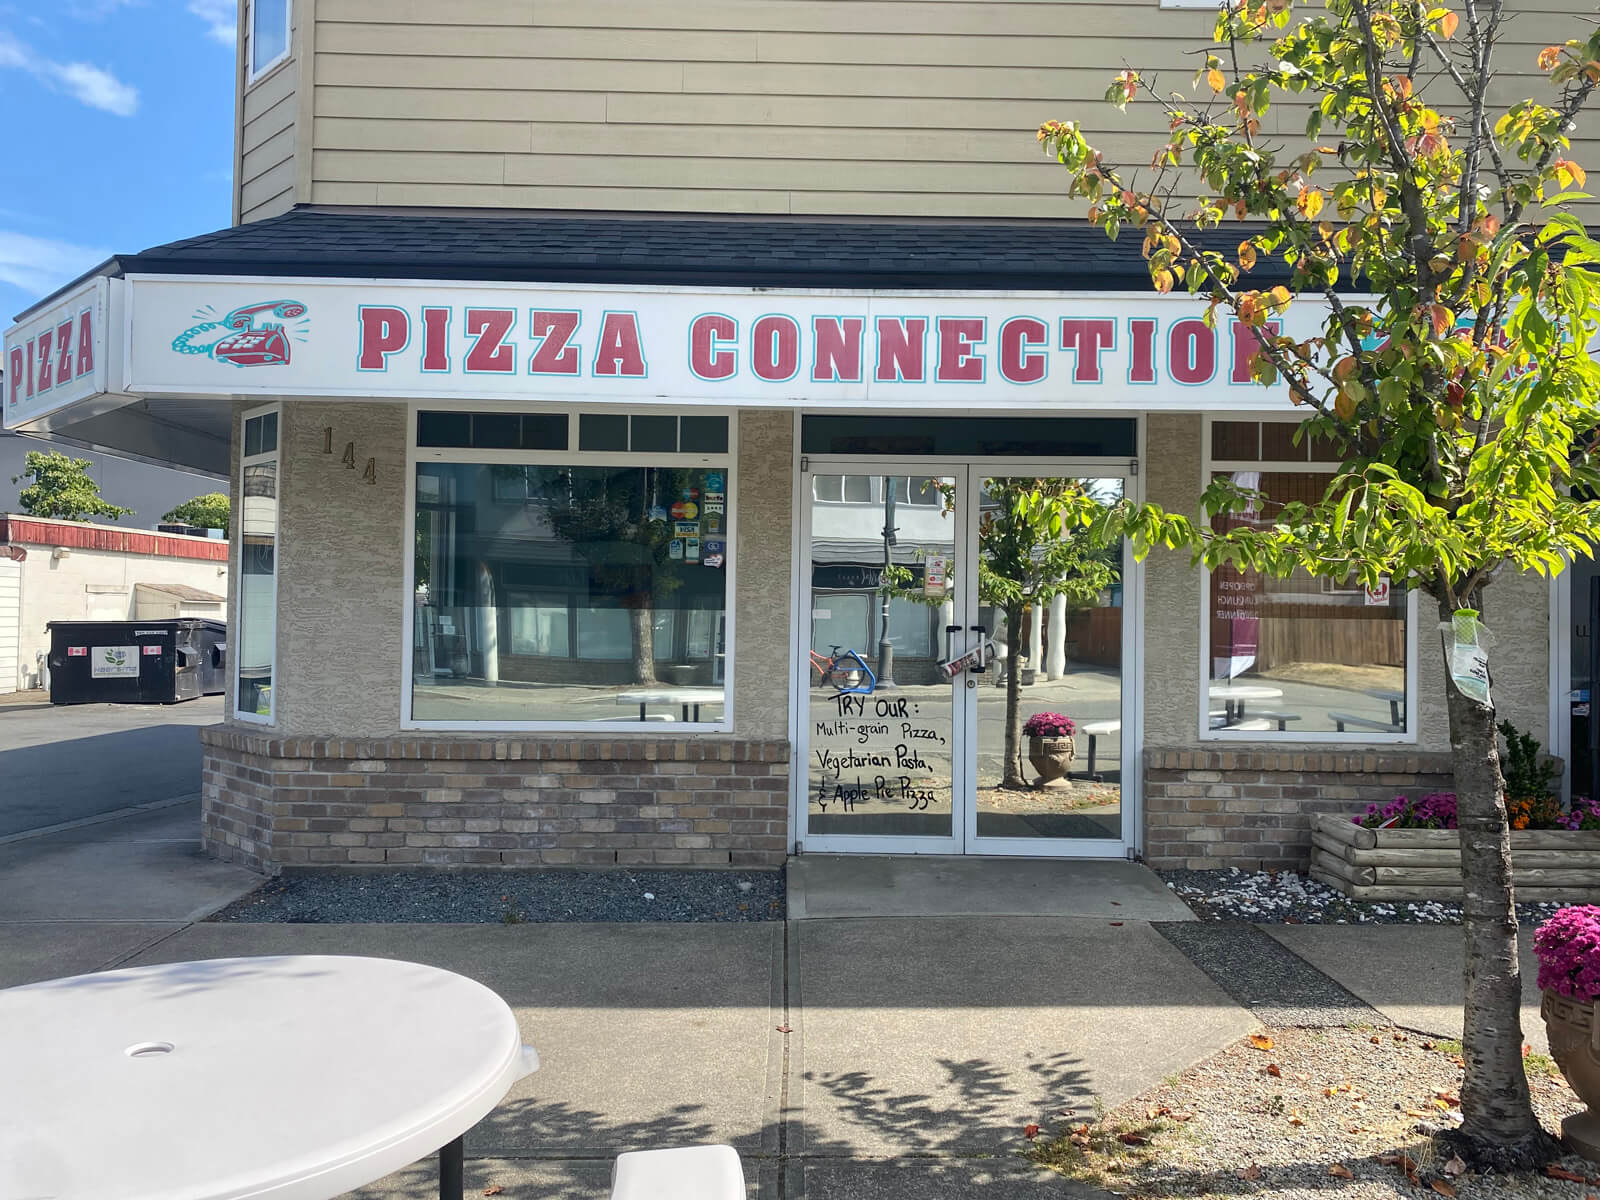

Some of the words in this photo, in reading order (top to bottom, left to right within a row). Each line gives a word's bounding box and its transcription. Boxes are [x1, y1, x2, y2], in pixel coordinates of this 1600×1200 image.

[9, 306, 96, 408] PIZZA
[357, 304, 648, 379] PIZZA
[322, 426, 377, 486] 144
[828, 691, 865, 717] TRY
[816, 721, 889, 743] Multi-grain
[901, 722, 946, 745] Pizza,
[816, 747, 891, 779] Vegetarian
[894, 744, 933, 773] Pasta,
[818, 776, 827, 812] &
[833, 776, 871, 812] Apple
[874, 775, 895, 799] Pie
[898, 776, 938, 810] Pizza
